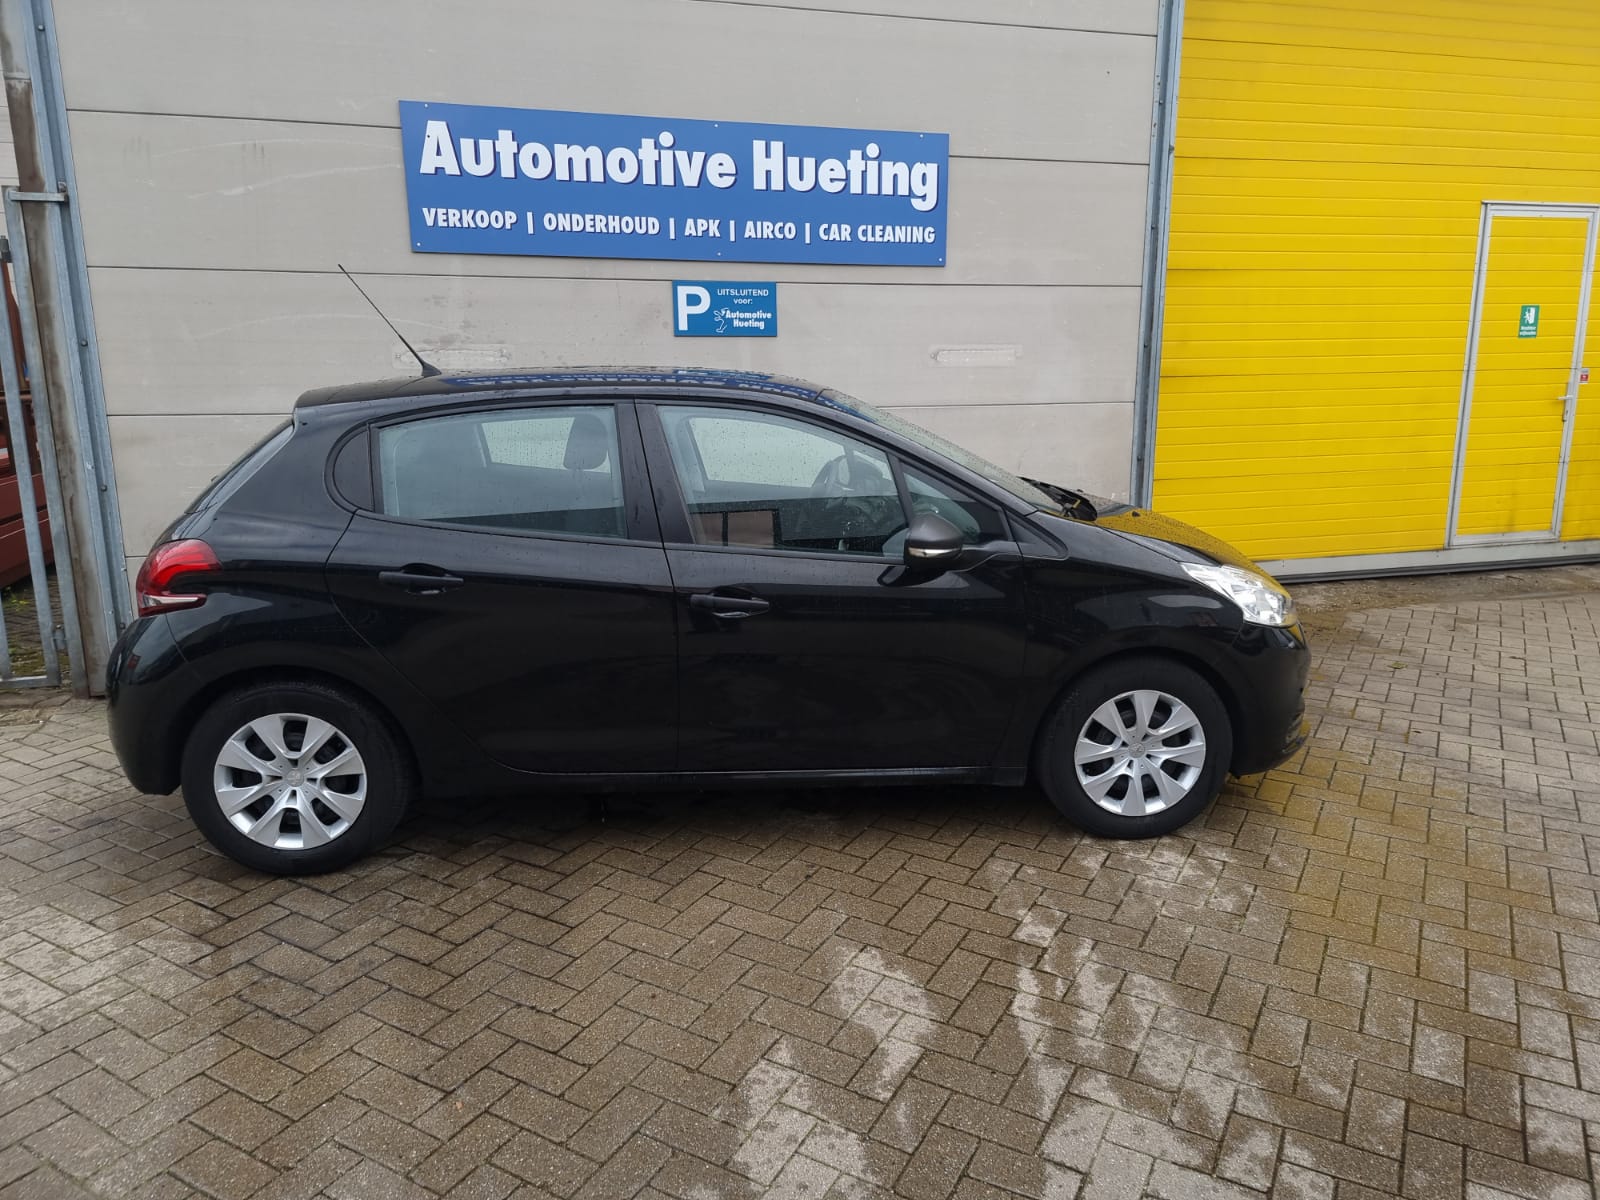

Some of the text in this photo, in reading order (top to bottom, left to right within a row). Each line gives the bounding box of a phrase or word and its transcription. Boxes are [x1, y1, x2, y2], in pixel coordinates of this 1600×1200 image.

[420, 120, 939, 212] Automotive Hueting
[422, 207, 518, 230] VERKOOP
[543, 212, 661, 236] ONDERHOUD
[684, 218, 721, 238] APK
[743, 220, 797, 240] AIRCO
[818, 223, 852, 242] CAR
[857, 224, 936, 244] CLEANING
[717, 288, 769, 297] UITSLUITEND
[677, 285, 711, 331] P
[725, 310, 772, 319] Automotive
[733, 319, 765, 330] Hueting
